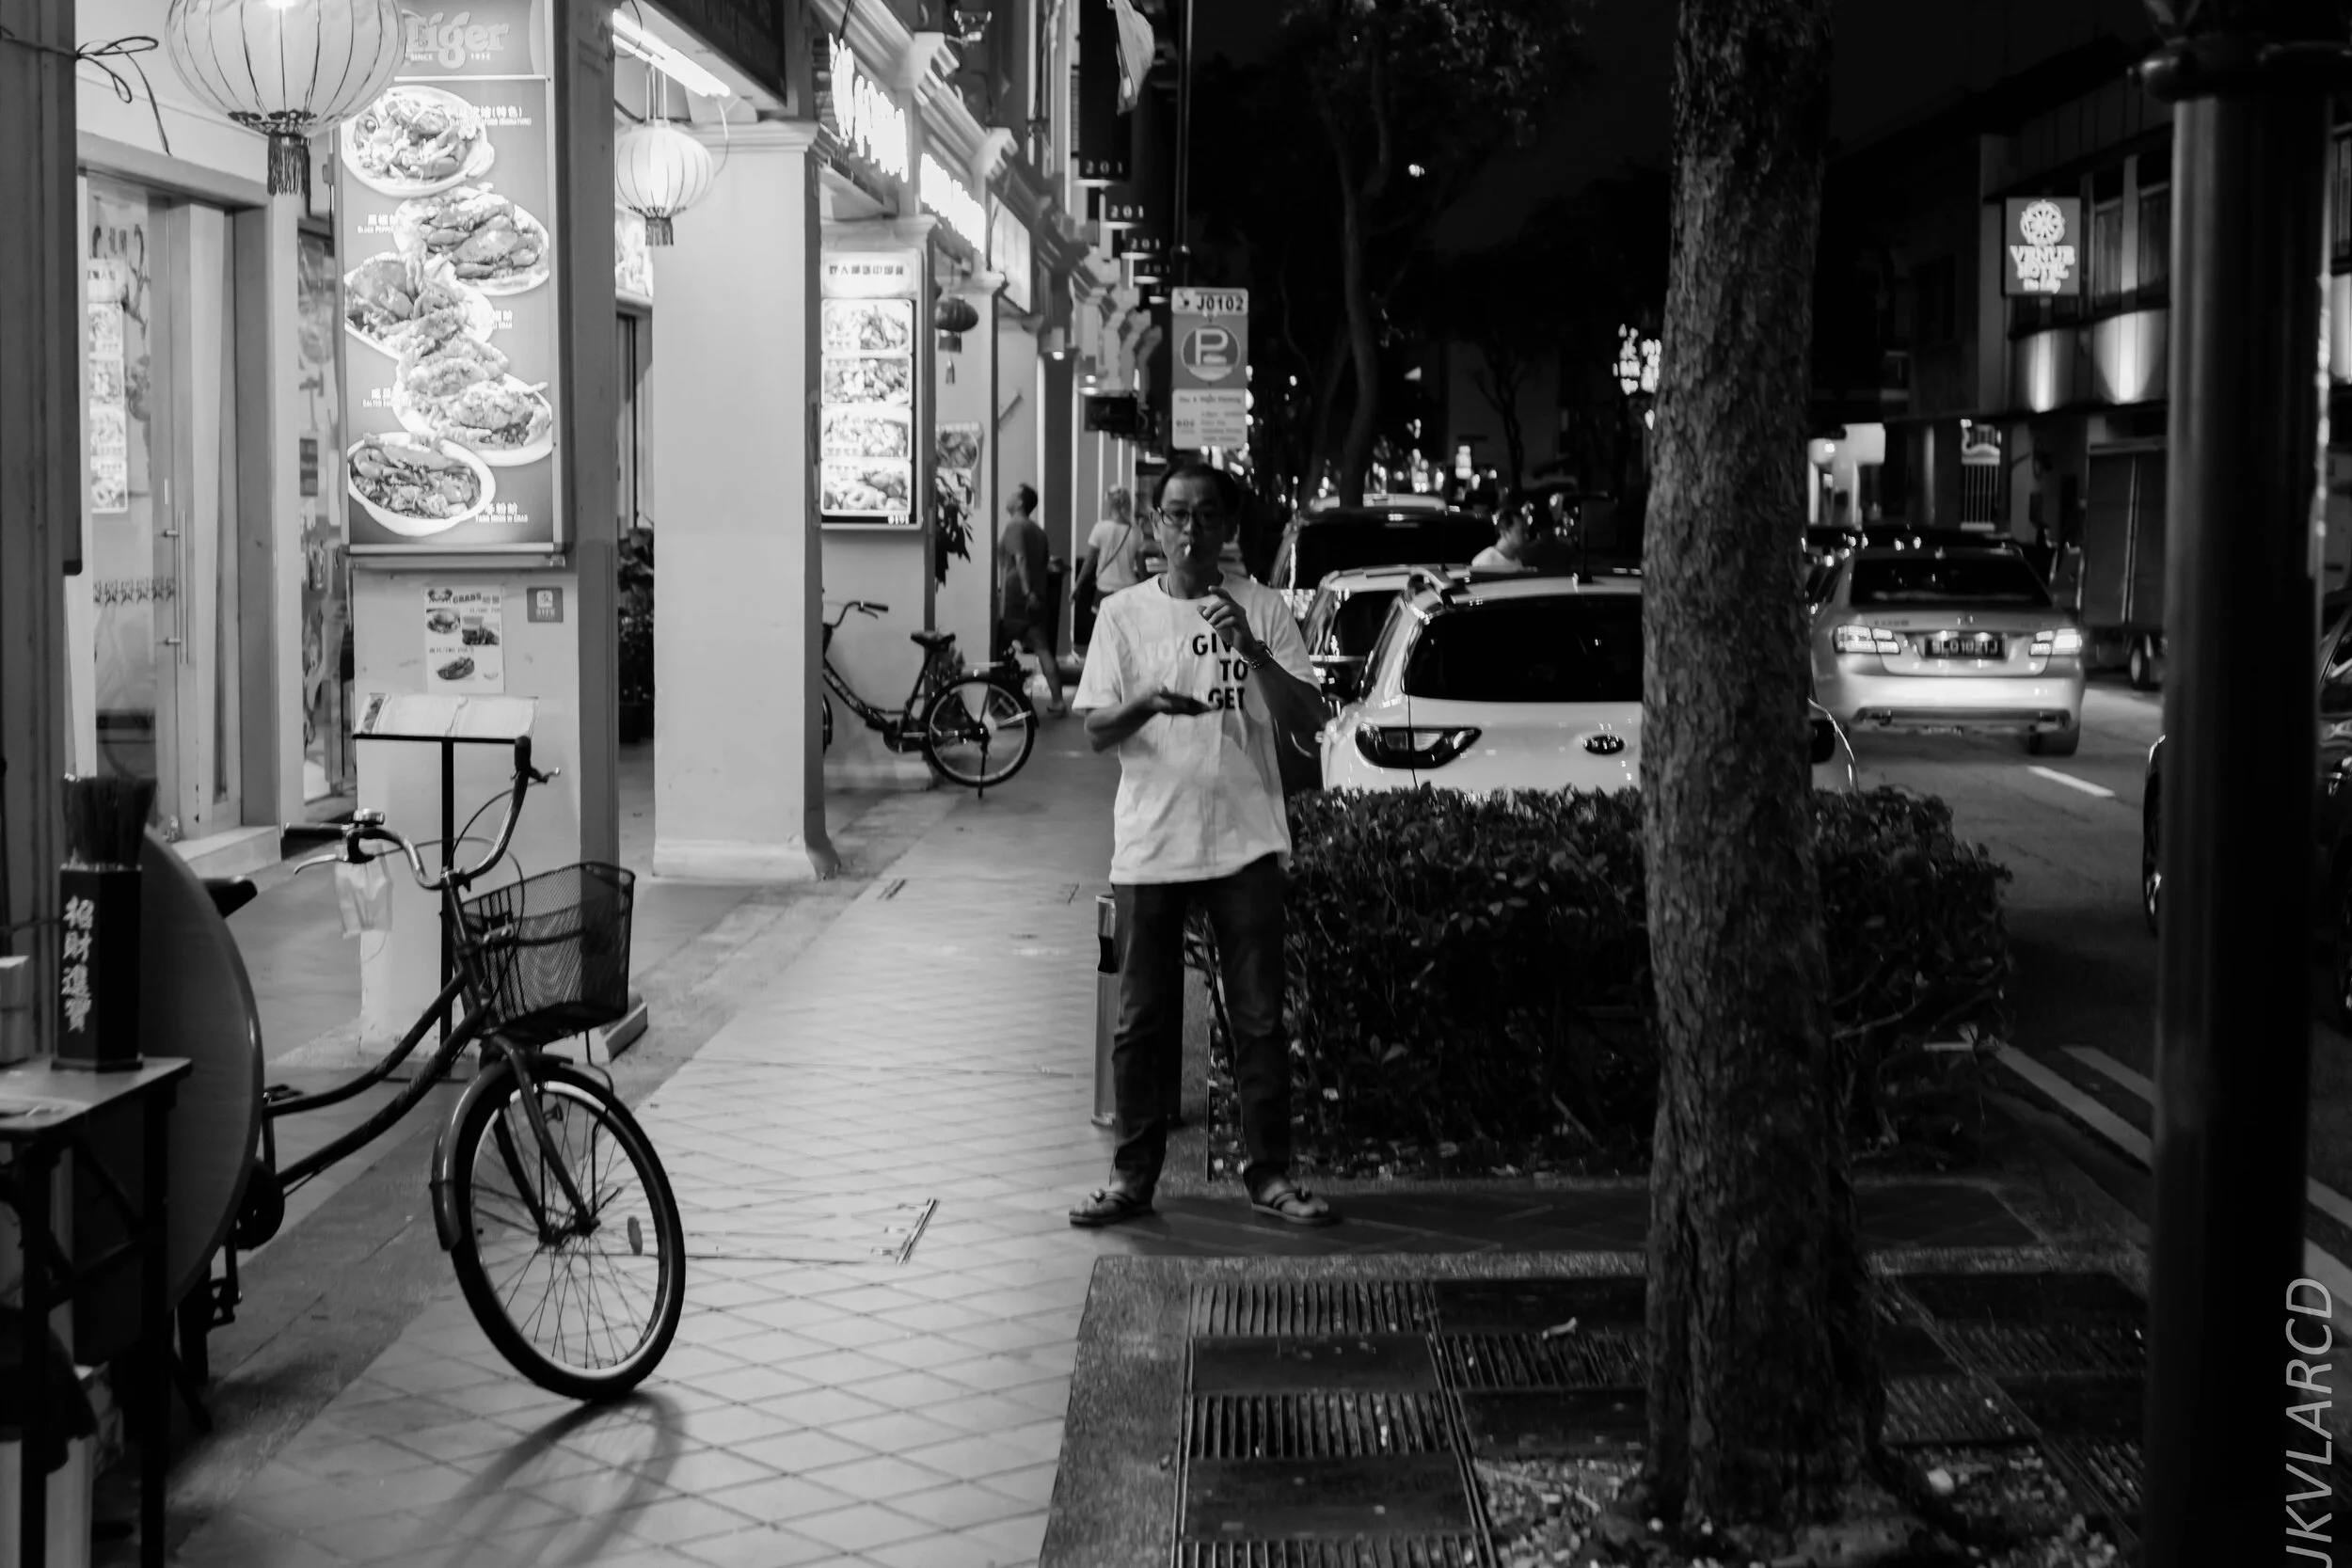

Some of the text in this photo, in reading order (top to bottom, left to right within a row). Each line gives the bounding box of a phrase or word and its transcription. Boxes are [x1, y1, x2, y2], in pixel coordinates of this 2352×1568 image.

[401, 9, 511, 70] Tiger
[410, 53, 434, 61] SINCE
[1085, 160, 1123, 175] 201
[1110, 204, 1145, 219] 201
[1131, 237, 1161, 250] 201
[1197, 295, 1244, 311] J0102
[453, 593, 482, 604] CRABS
[1219, 659, 1248, 682] TO
[1208, 688, 1245, 710] GET
